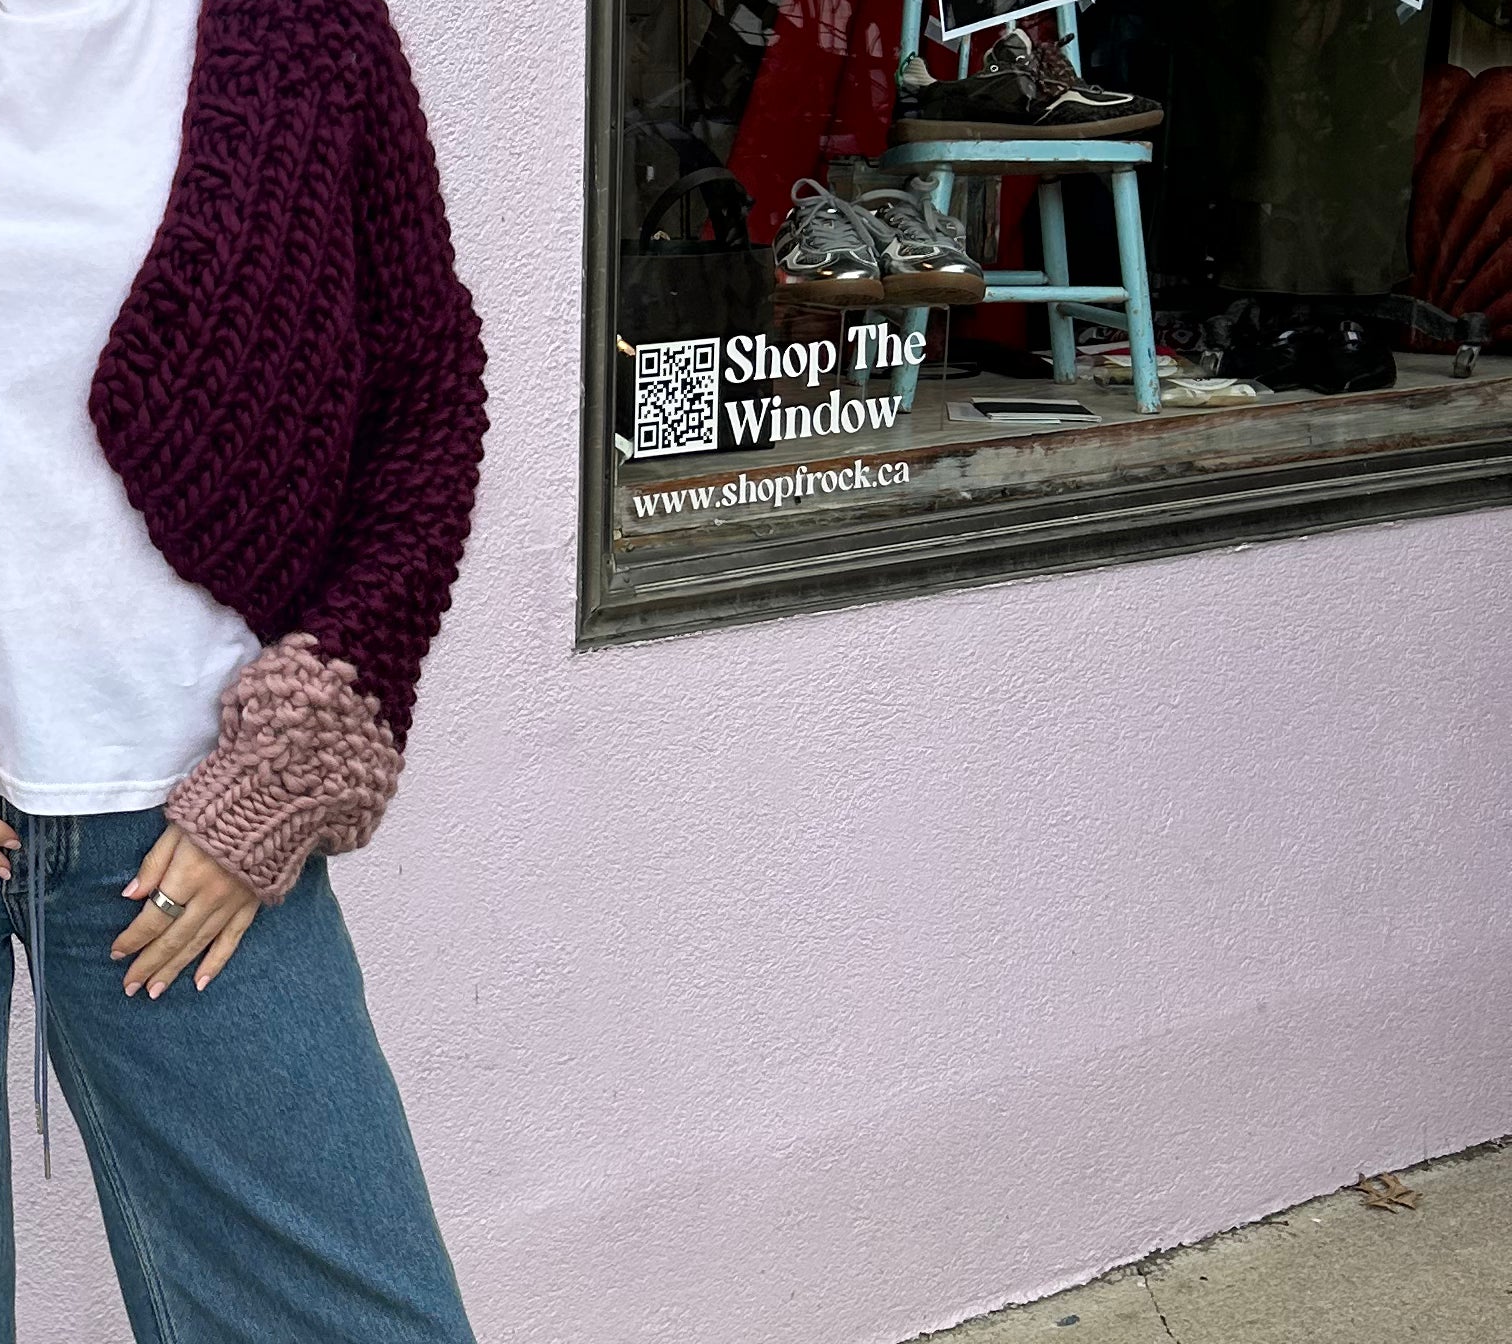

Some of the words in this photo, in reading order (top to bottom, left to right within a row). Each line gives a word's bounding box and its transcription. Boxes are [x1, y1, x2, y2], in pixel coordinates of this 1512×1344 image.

[724, 333, 837, 388] Shop
[847, 322, 927, 371] The
[724, 389, 903, 446] Window
[632, 458, 910, 518] www.shopfrock.ca
